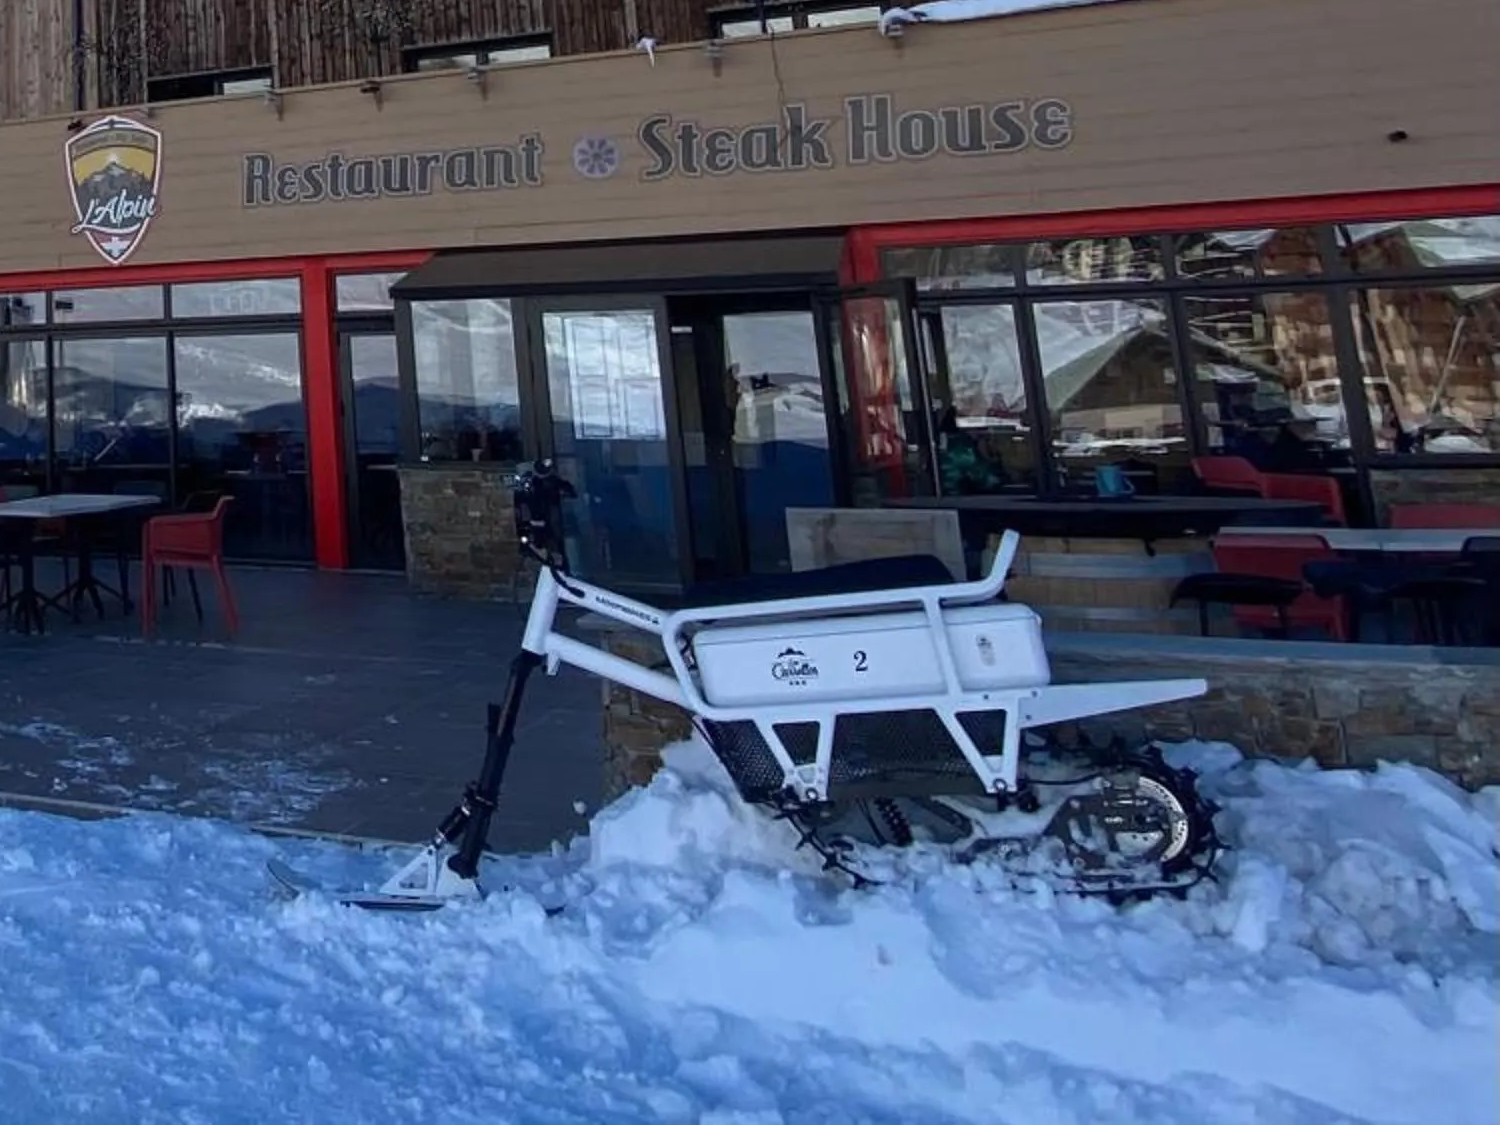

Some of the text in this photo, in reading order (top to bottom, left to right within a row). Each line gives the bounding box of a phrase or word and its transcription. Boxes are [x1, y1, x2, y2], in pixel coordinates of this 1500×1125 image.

[243, 134, 544, 208] Restaurant
[639, 103, 834, 181] Steak
[844, 93, 1074, 164] House
[71, 188, 158, 234] L'Alpin
[853, 650, 869, 672] 2
